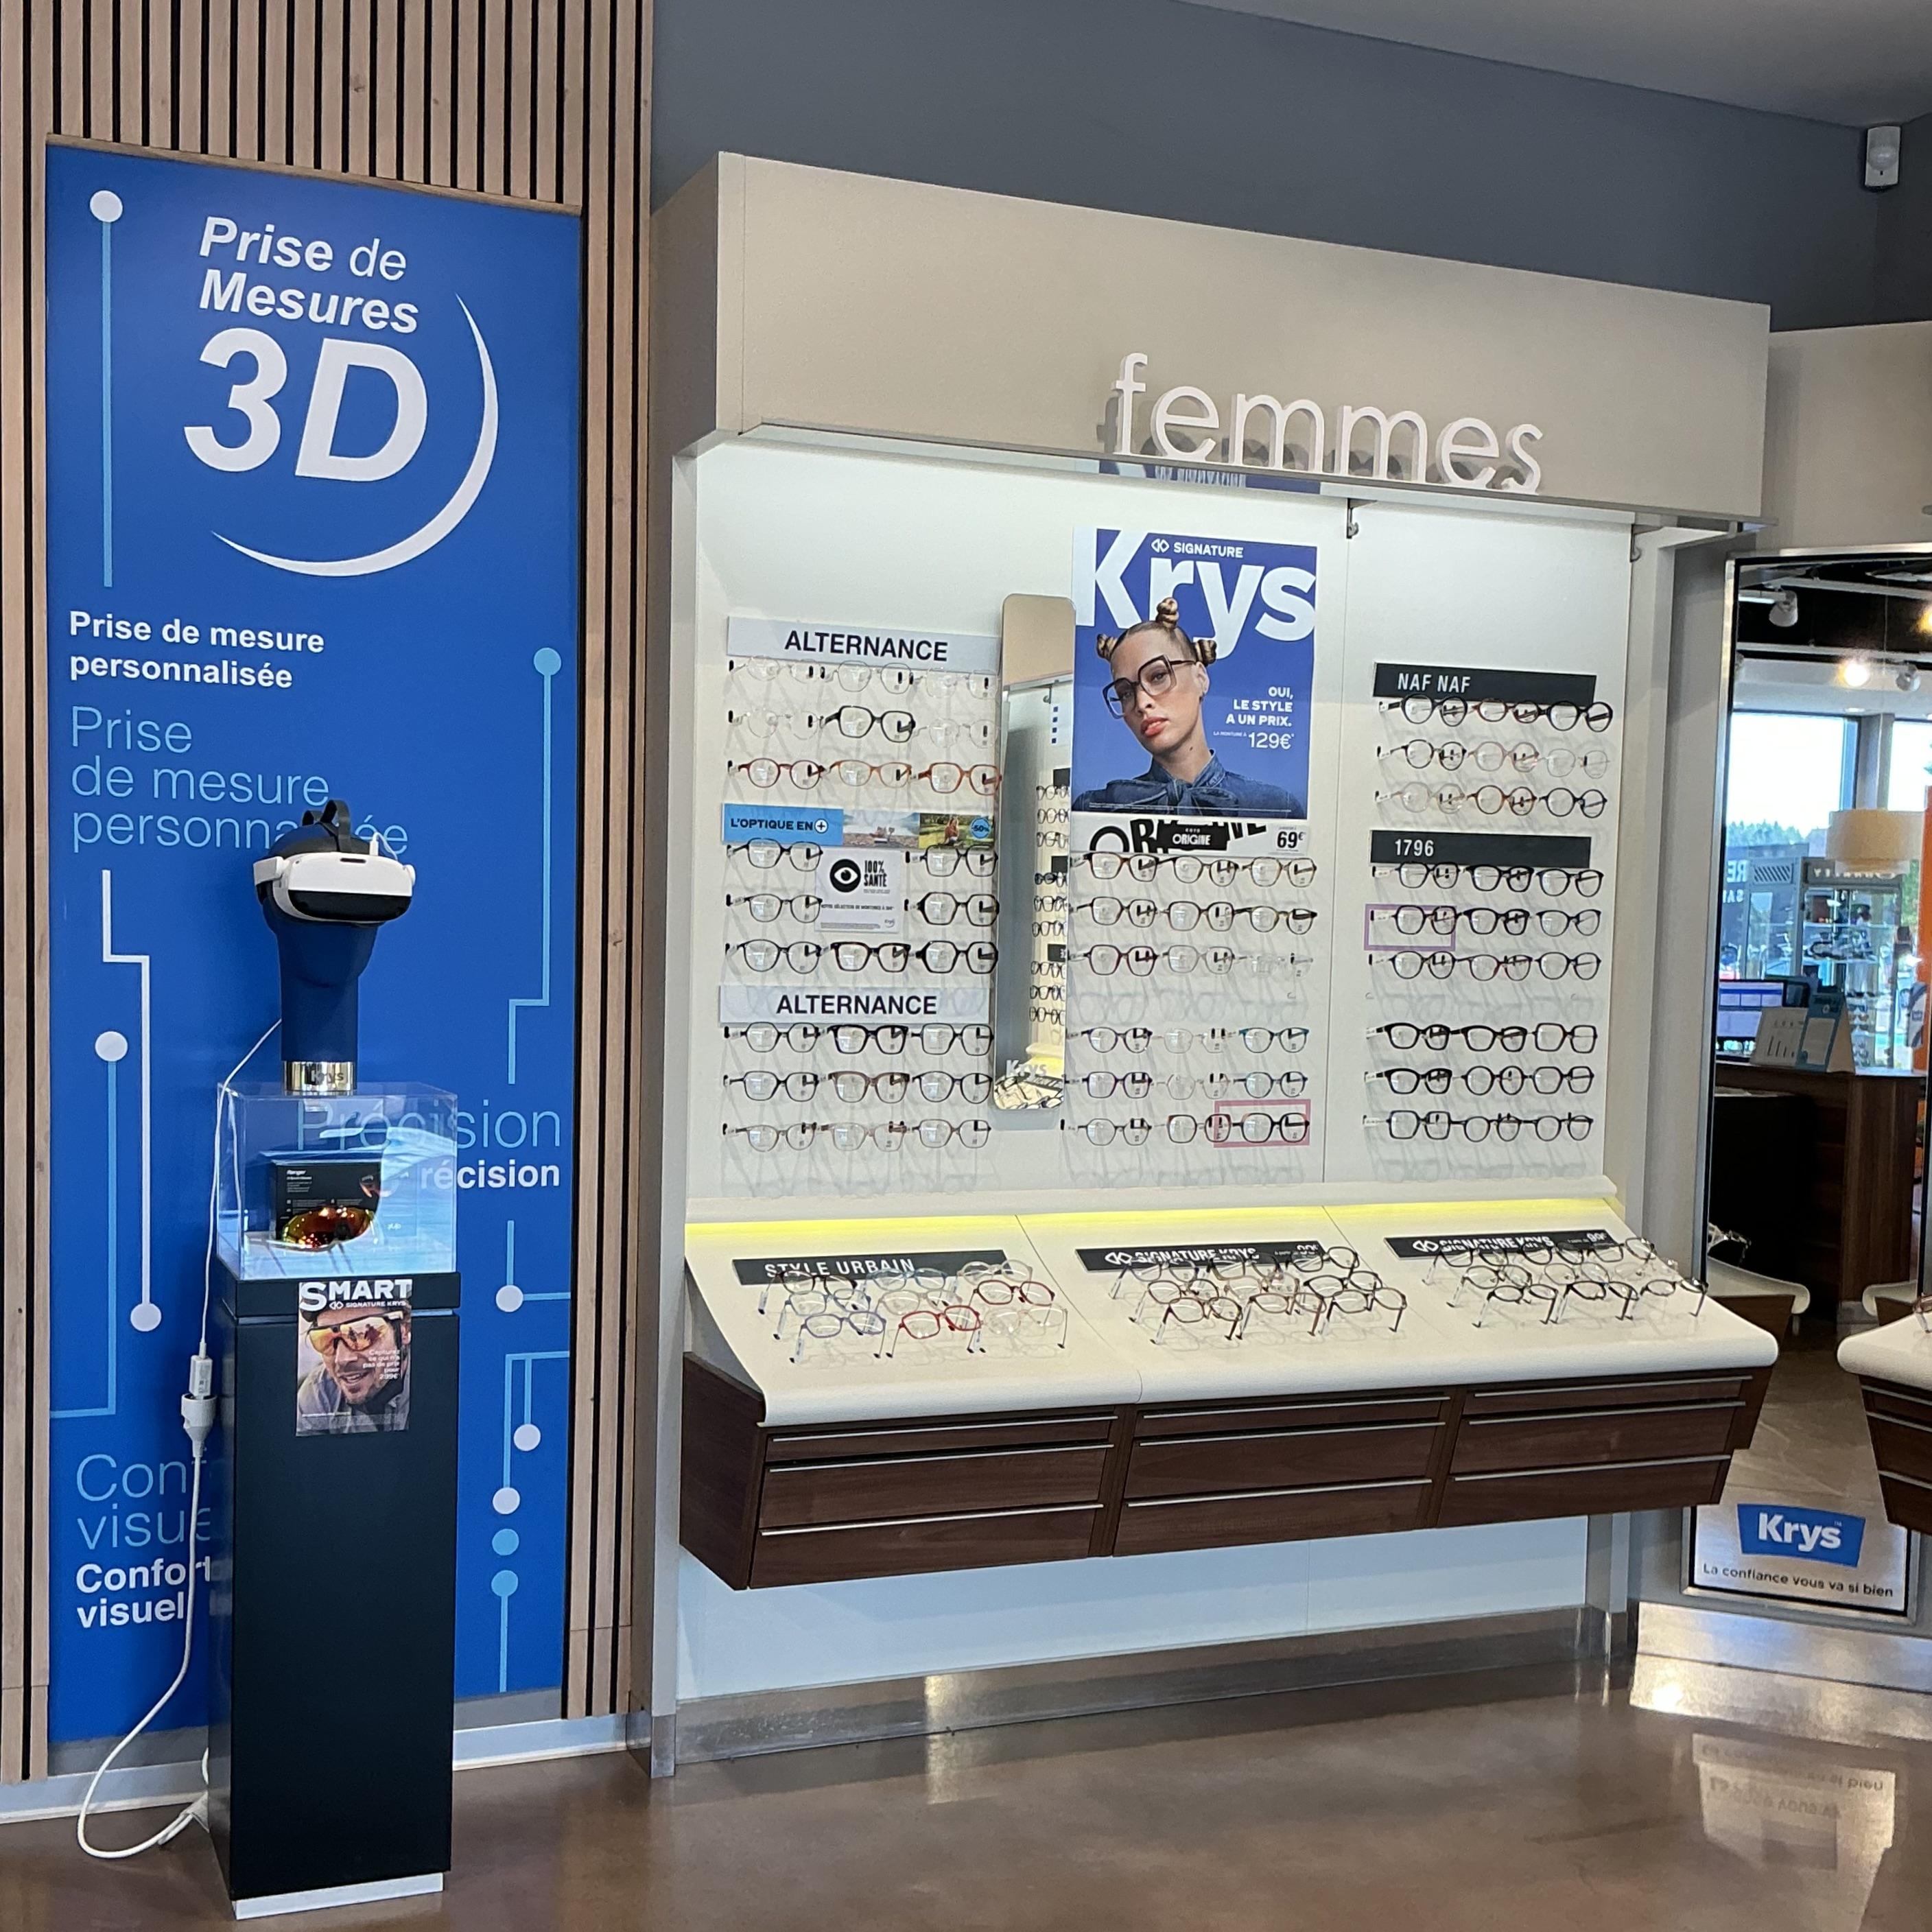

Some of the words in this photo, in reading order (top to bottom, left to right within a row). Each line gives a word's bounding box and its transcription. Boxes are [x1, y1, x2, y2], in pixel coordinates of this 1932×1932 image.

[199, 217, 334, 272] Prise
[349, 237, 407, 281] de
[199, 268, 419, 333] Mesures
[184, 327, 428, 482] 3D
[1111, 351, 1543, 495] femmes
[1173, 541, 1244, 558] SIGNATURE
[1073, 526, 1317, 659] Krys
[69, 610, 152, 642] Prise
[162, 617, 200, 645] de
[209, 623, 325, 653] mesure
[784, 629, 949, 662] ALTERNANCE
[69, 655, 294, 688] personnalisée
[1398, 672, 1432, 692] NAF
[1437, 674, 1471, 694] NAF
[1233, 699, 1249, 710] LE
[1251, 700, 1293, 713] STYLE
[1269, 686, 1293, 700] OUI,
[72, 705, 193, 753] Prise
[1225, 713, 1235, 724] A
[1238, 714, 1256, 725] UN
[1258, 714, 1292, 727] PRIX.
[71, 755, 134, 797] de
[152, 767, 329, 807] mesure
[731, 817, 794, 832] L'OPTIQUE
[797, 821, 813, 832] EN
[1395, 838, 1435, 858] 1796
[864, 860, 884, 873] 100%
[864, 873, 888, 888] SANTÉ
[776, 994, 937, 1015] ALTERNANCE
[298, 1099, 560, 1151] Précision
[421, 1159, 560, 1190] récision
[764, 1262, 831, 1278] STYLE
[836, 1258, 916, 1275] URBAIN
[299, 1279, 412, 1311] SMART
[1758, 1511, 1841, 1553] Krys
[1703, 1562, 1719, 1575] La
[1722, 1566, 1789, 1585] confiance
[1792, 1575, 1825, 1590] vous
[1828, 1581, 1844, 1592] va
[1863, 1582, 1894, 1598] bien
[77, 1591, 185, 1629] visuel
